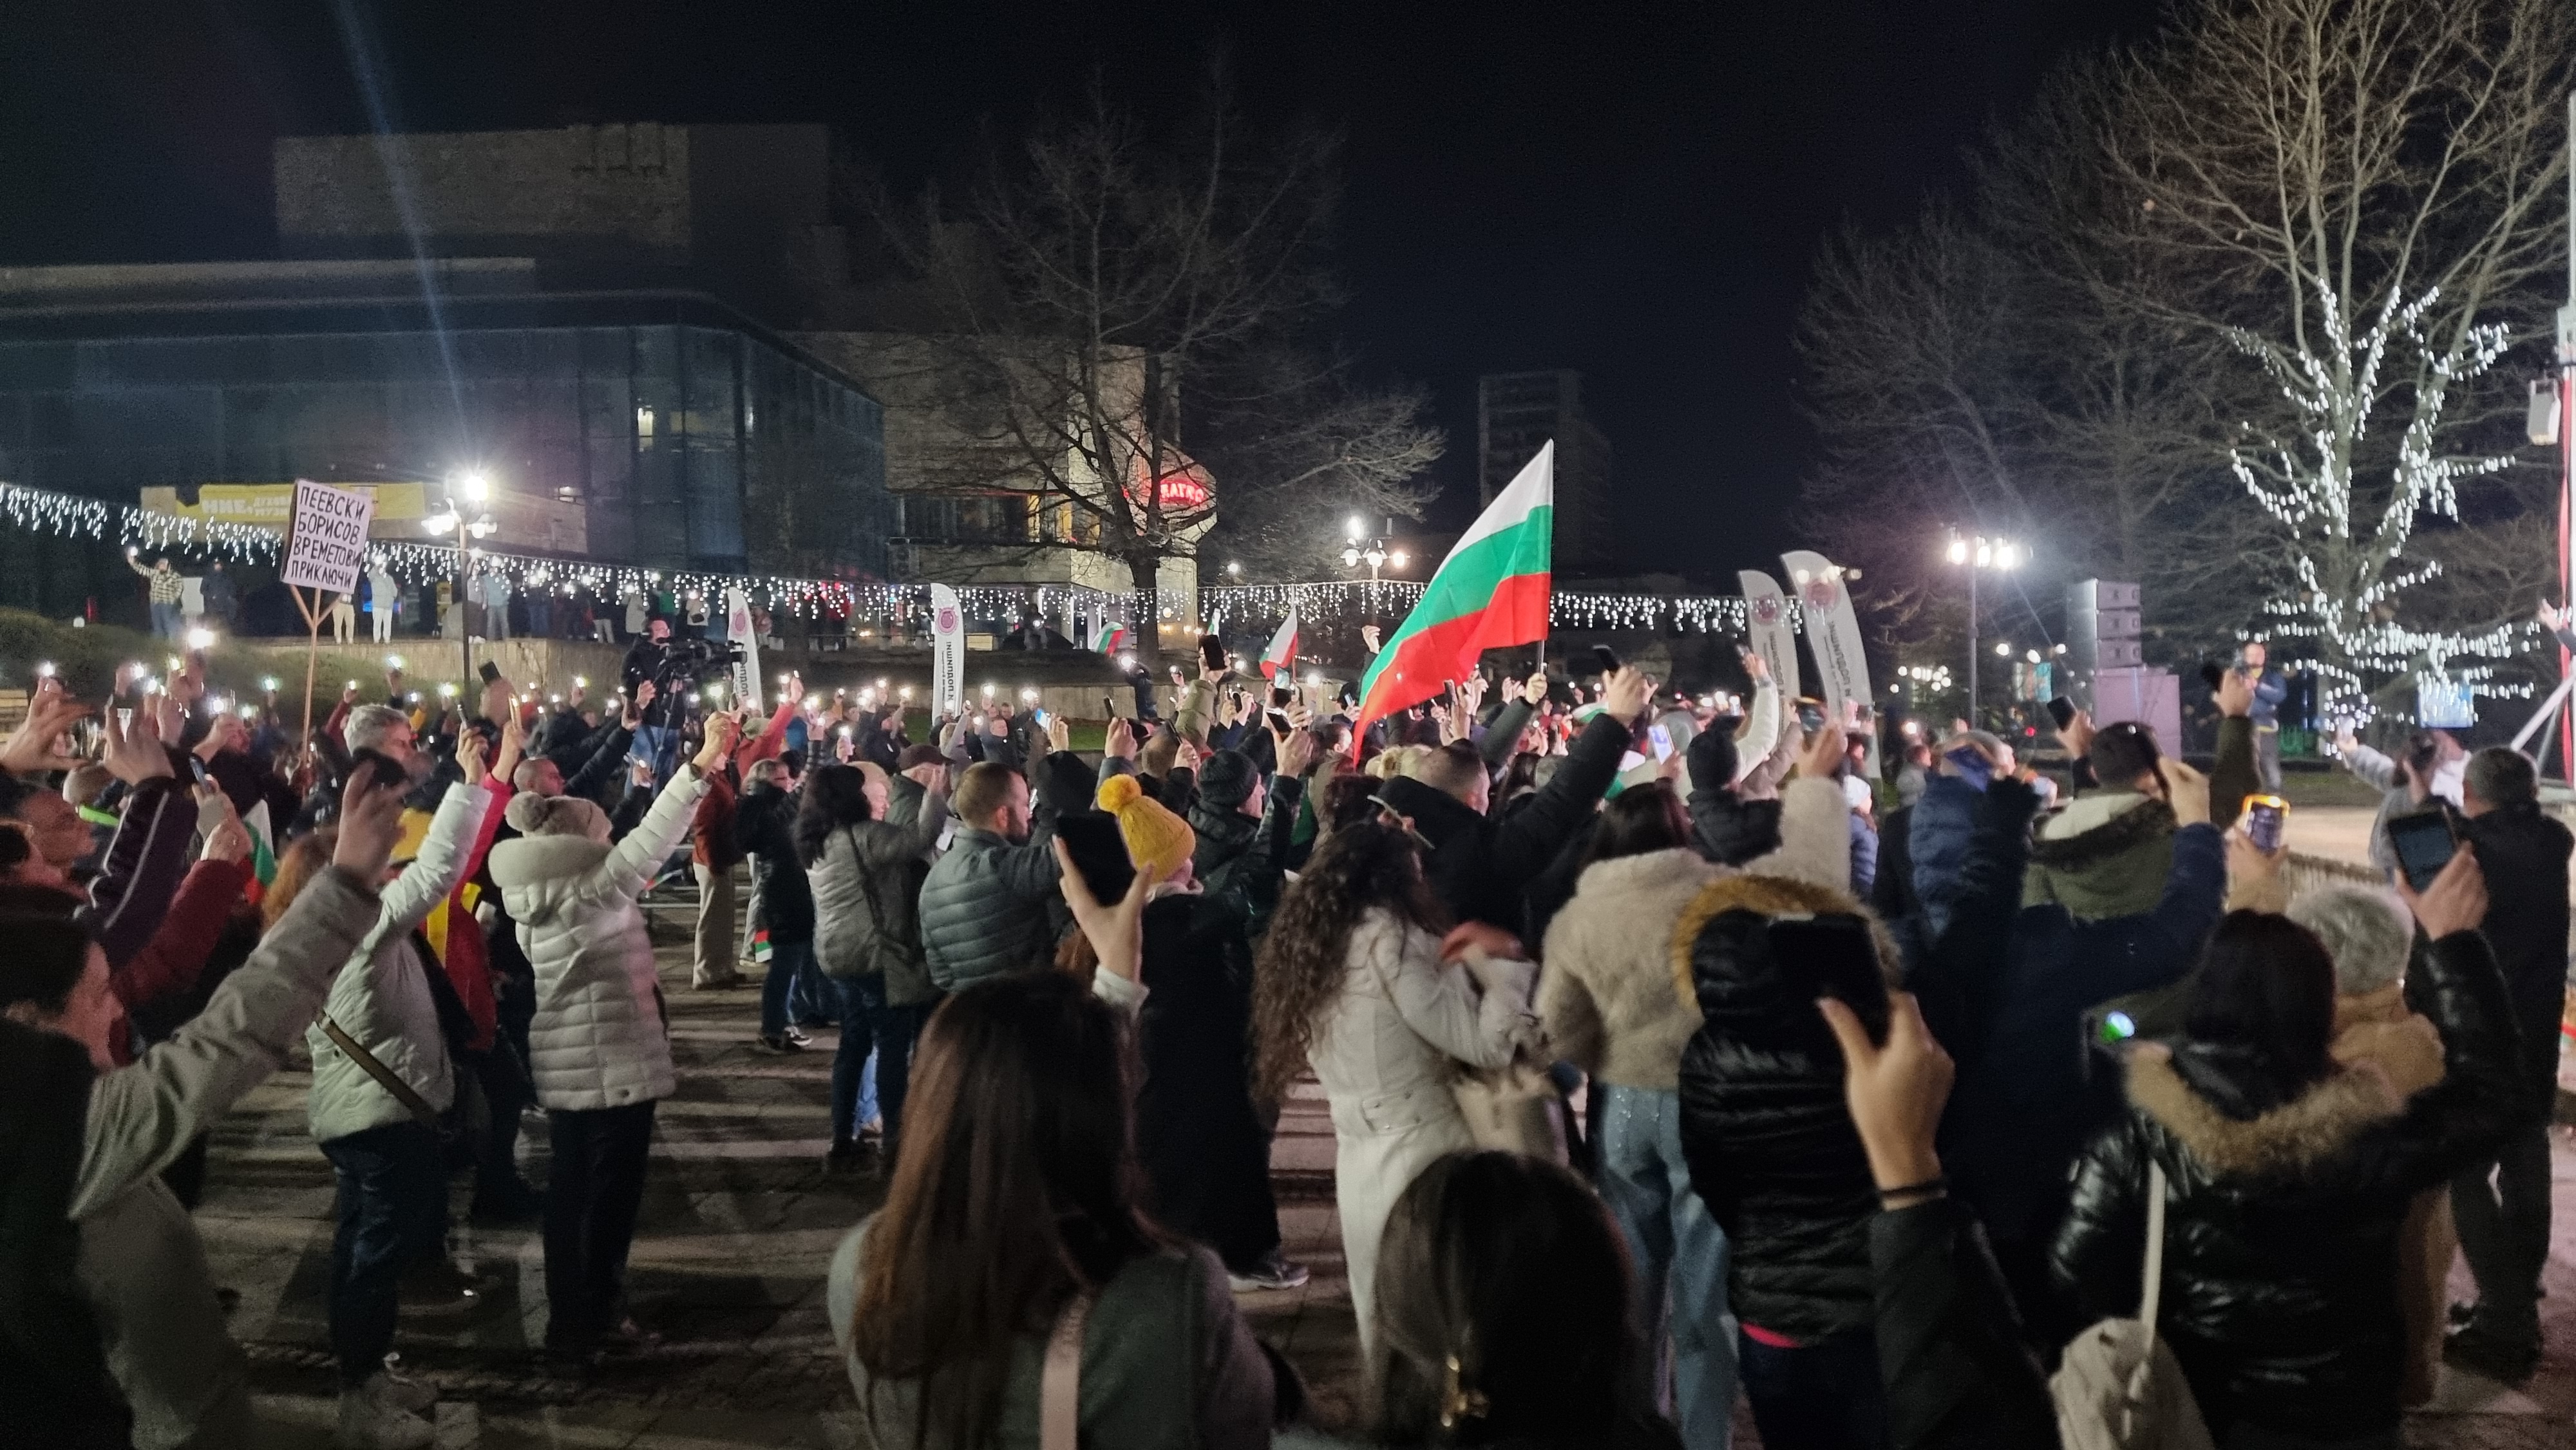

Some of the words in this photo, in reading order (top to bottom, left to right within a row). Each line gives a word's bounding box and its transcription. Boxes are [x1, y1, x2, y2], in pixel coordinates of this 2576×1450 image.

[300, 486, 365, 520] ПЕЕВСКИ
[298, 512, 361, 545] БОРИСОВ
[290, 560, 352, 588] ПРИКЛЮЧИ
